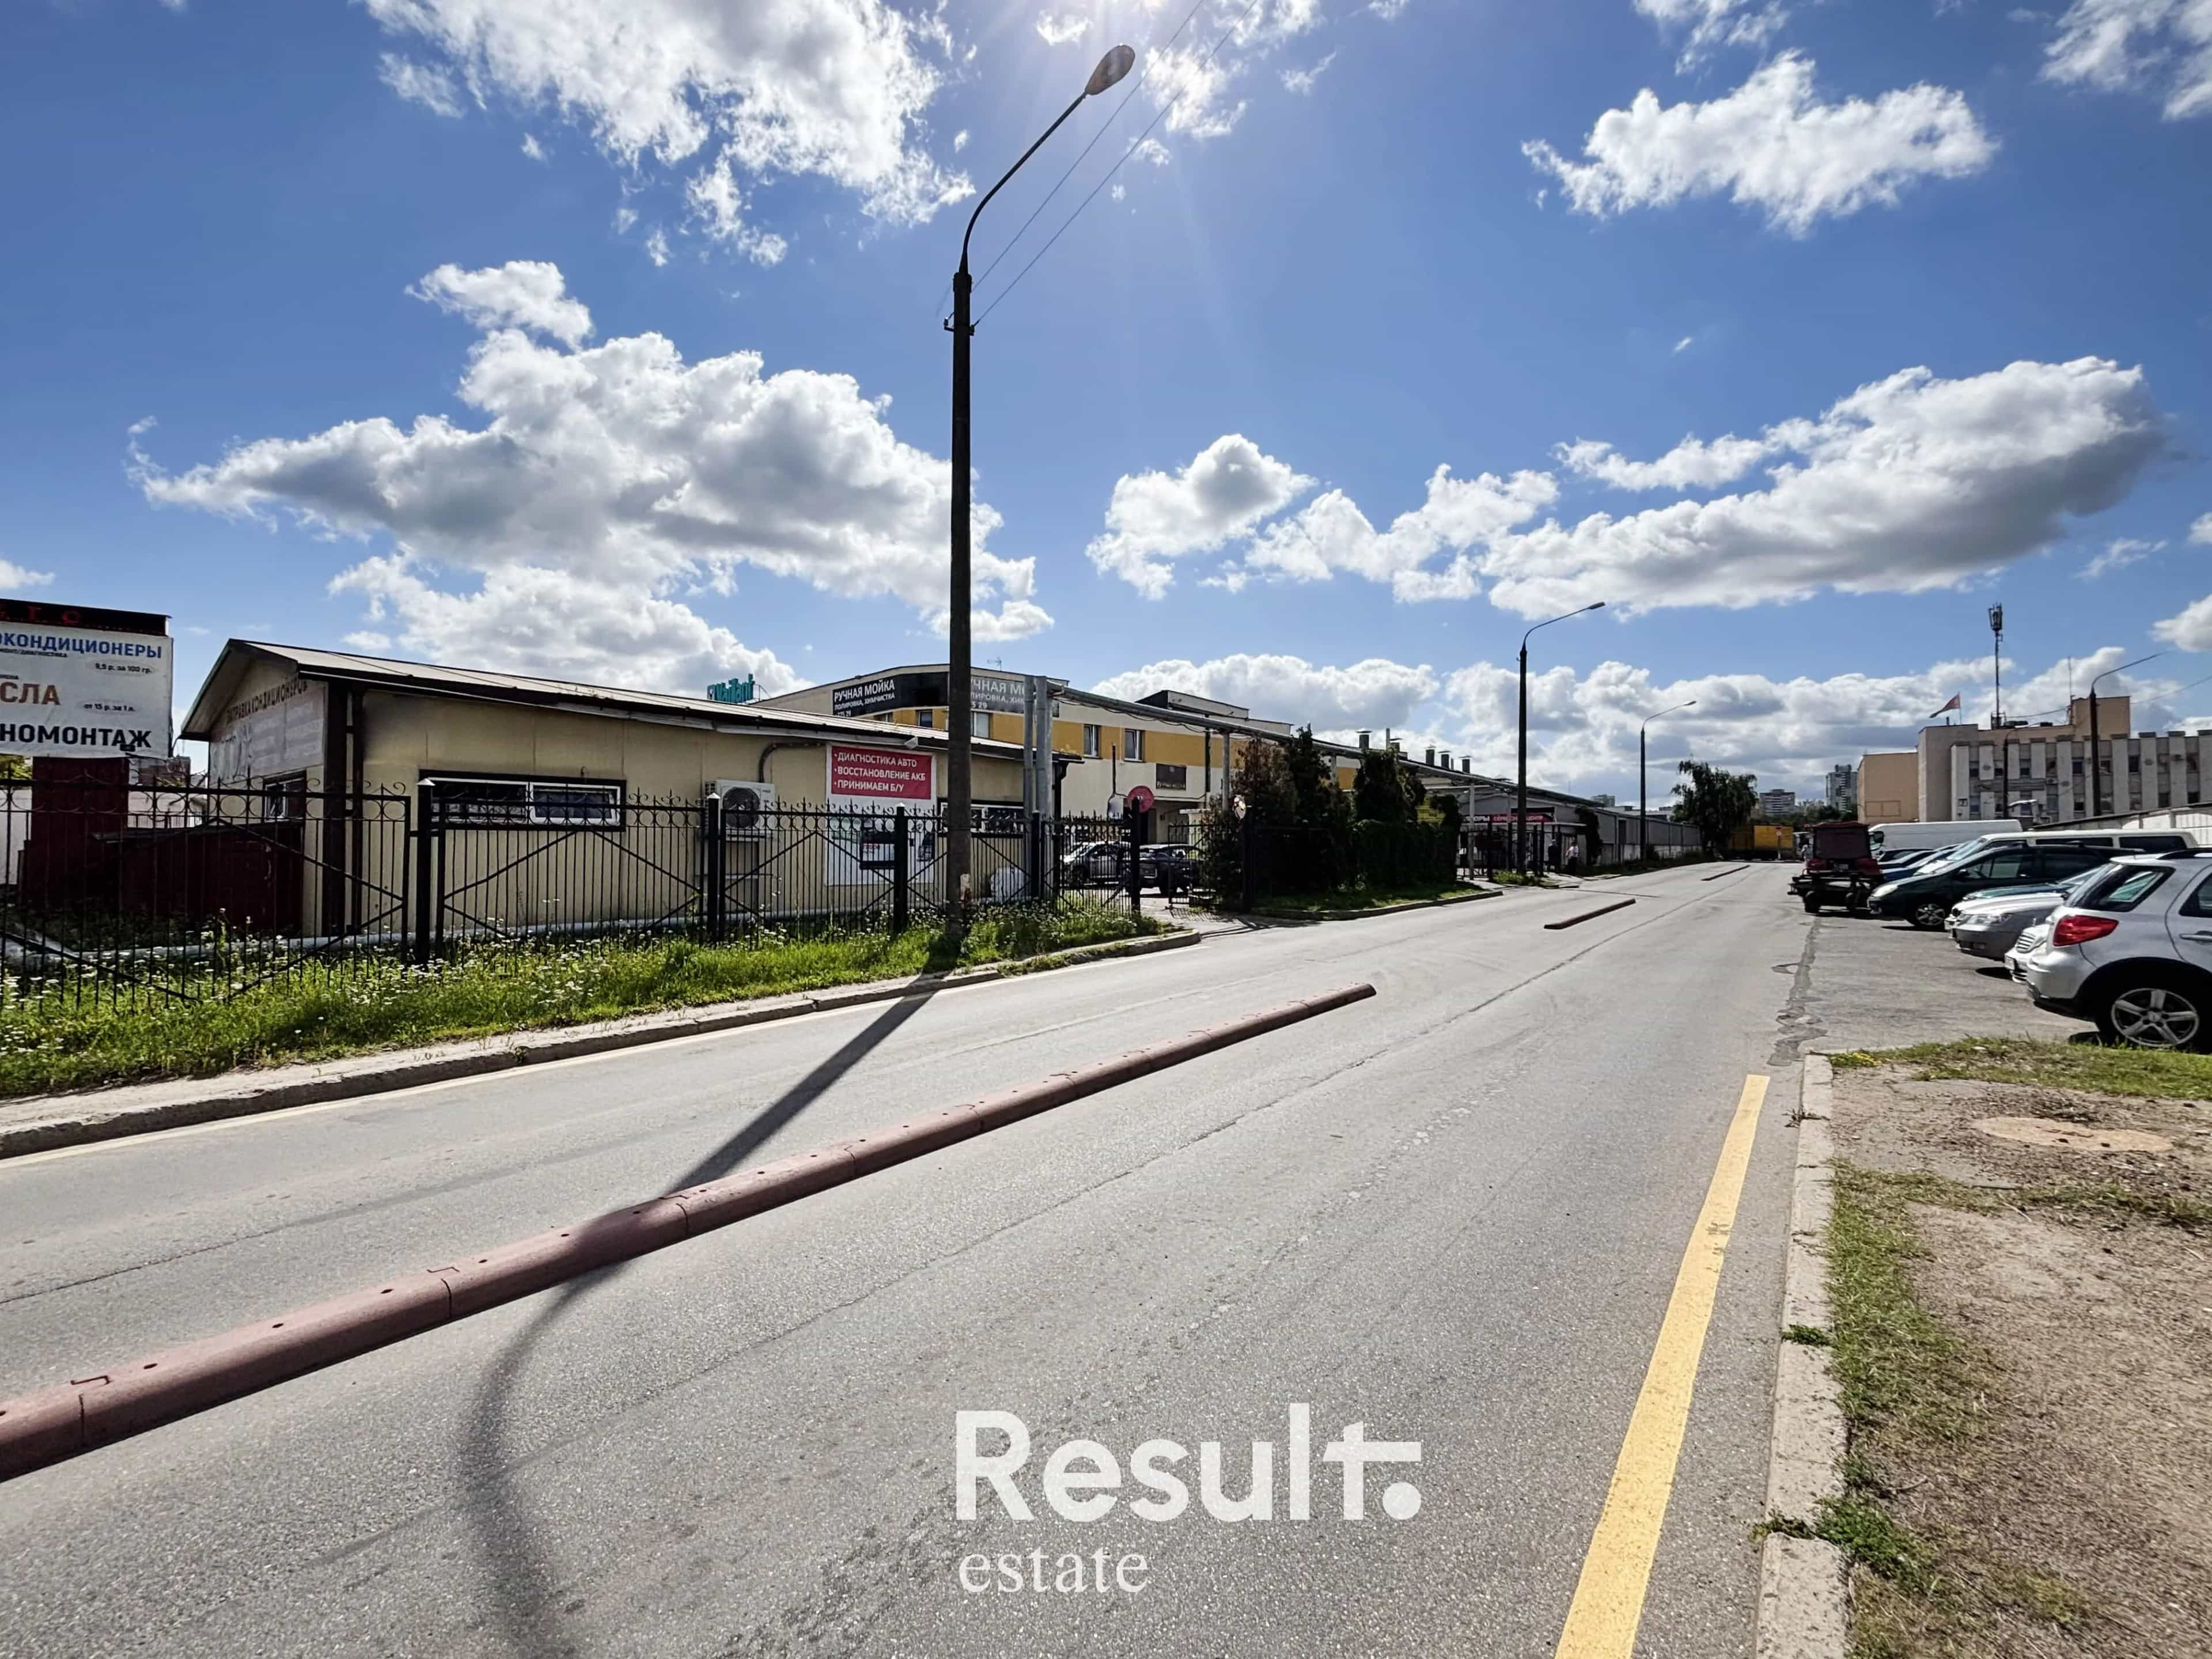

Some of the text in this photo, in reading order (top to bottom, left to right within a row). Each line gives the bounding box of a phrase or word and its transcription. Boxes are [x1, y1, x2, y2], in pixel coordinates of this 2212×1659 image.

[0, 632, 162, 658] КОНДИЦИОНЕРЫ
[834, 679, 895, 703] РУЧНАЯ МОЙКА
[970, 677, 1006, 694] ЧНАЯ
[0, 724, 151, 748] НОМОНТАЖ
[837, 752, 917, 767] ДИАГНОСТИКА АВТО
[837, 766, 926, 781] ВОССТАНОВЛЕНИЕ АКБ
[837, 779, 904, 792] ПРИНИМАЕМ Б/У
